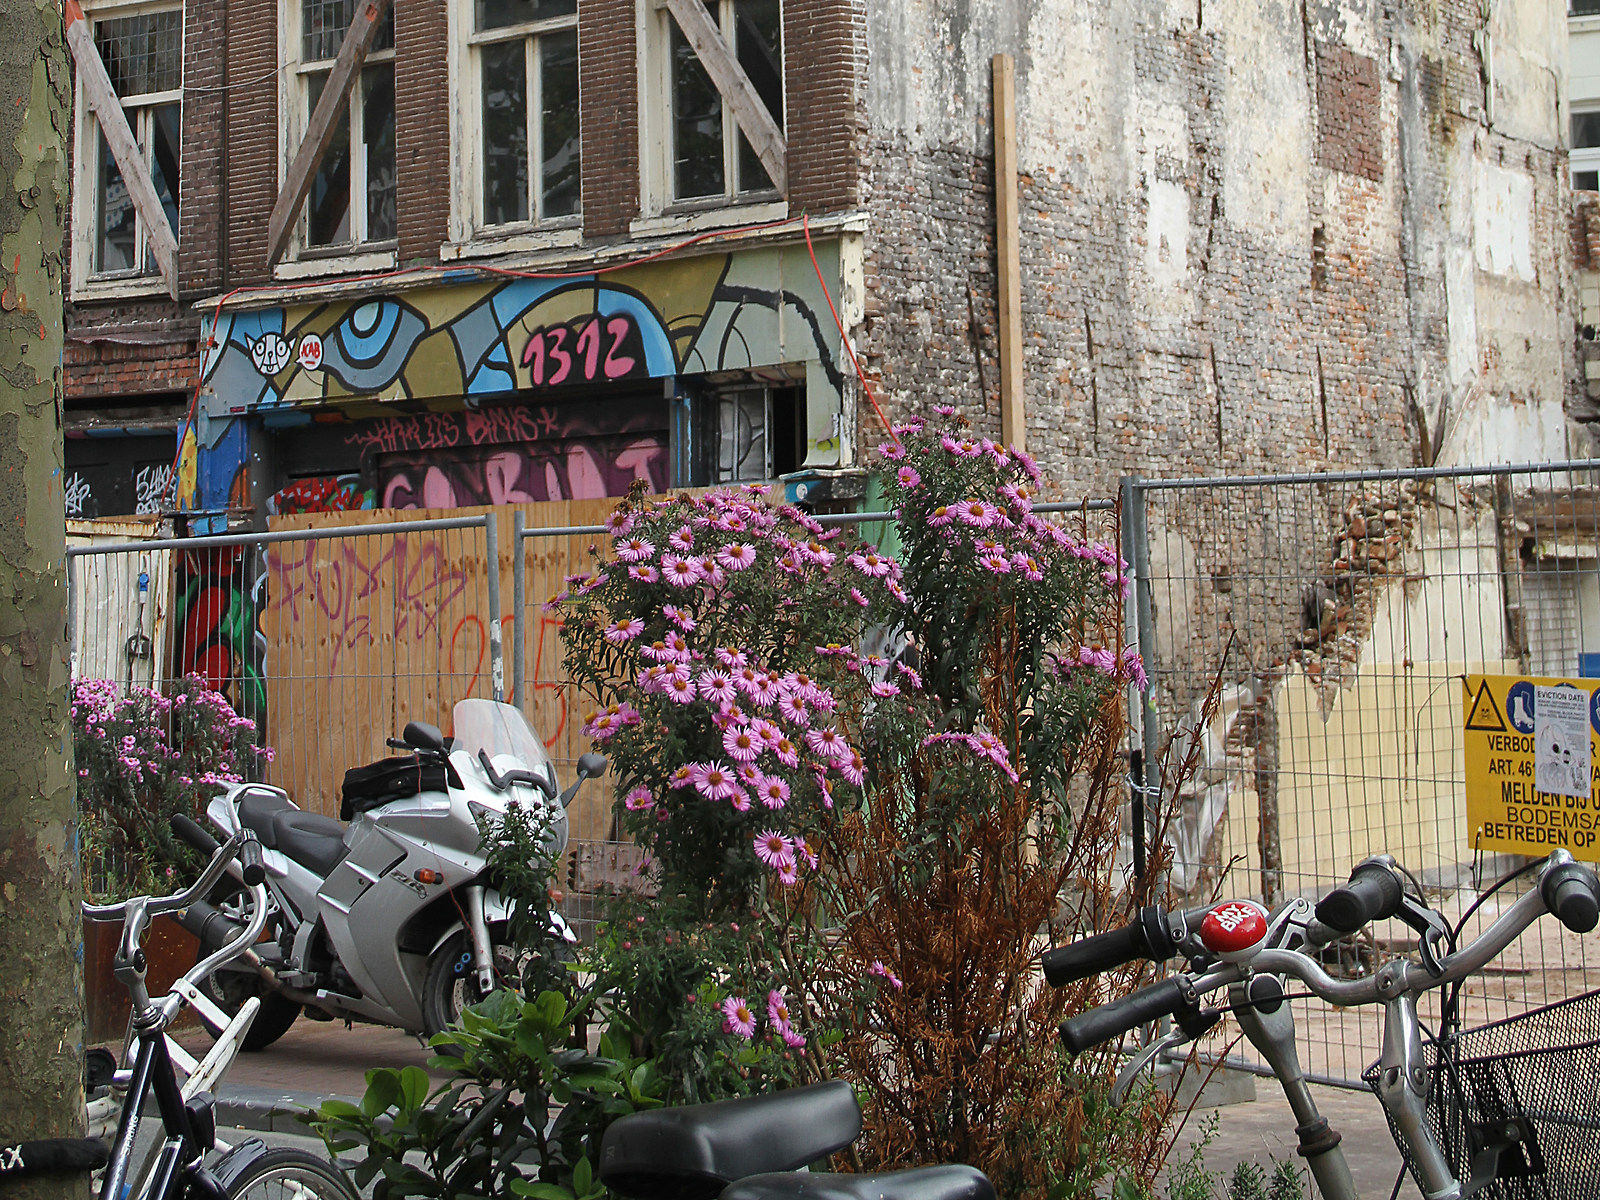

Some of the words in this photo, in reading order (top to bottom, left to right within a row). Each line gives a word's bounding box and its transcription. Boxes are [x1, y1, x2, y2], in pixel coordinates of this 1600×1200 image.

[301, 341, 321, 359] ACAB
[523, 318, 636, 386] 1312
[1537, 690, 1567, 700] EVICTION
[1567, 693, 1585, 703] DATE
[1488, 758, 1515, 776] ART.
[1501, 780, 1561, 807] MELDEN
[1484, 821, 1569, 846] BETREDEN
[1573, 830, 1596, 847] OP
[1215, 904, 1240, 922] MY
[1220, 906, 1257, 933] BIKE
